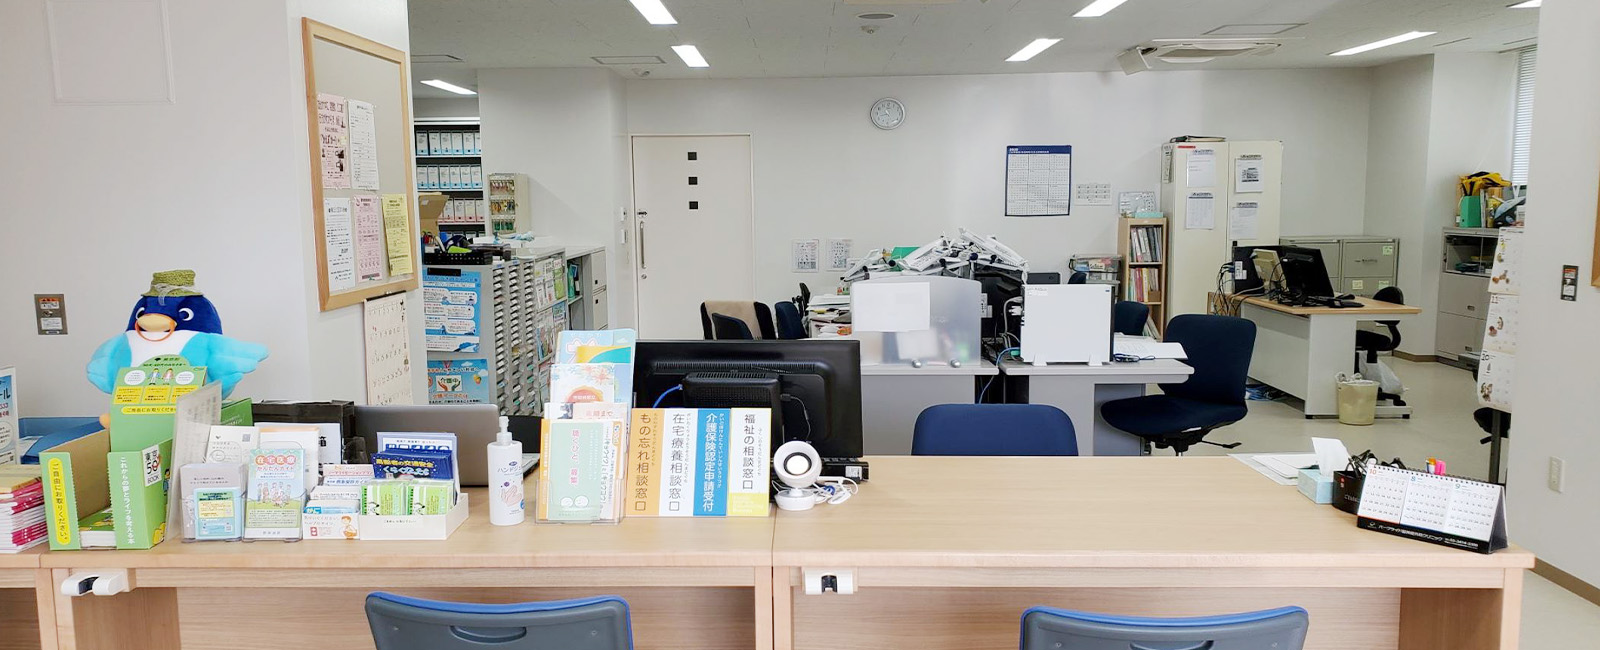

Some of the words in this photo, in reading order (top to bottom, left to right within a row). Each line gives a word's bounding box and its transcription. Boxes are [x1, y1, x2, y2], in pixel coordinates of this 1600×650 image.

[257, 455, 296, 465] 在宅医療
[634, 412, 651, 512] もの忘れ相談窓口
[668, 412, 685, 512] 在宅療養相談窓口
[702, 412, 718, 512] 介護保険認定申請受付
[742, 413, 756, 490] 福祉の相談窓口
